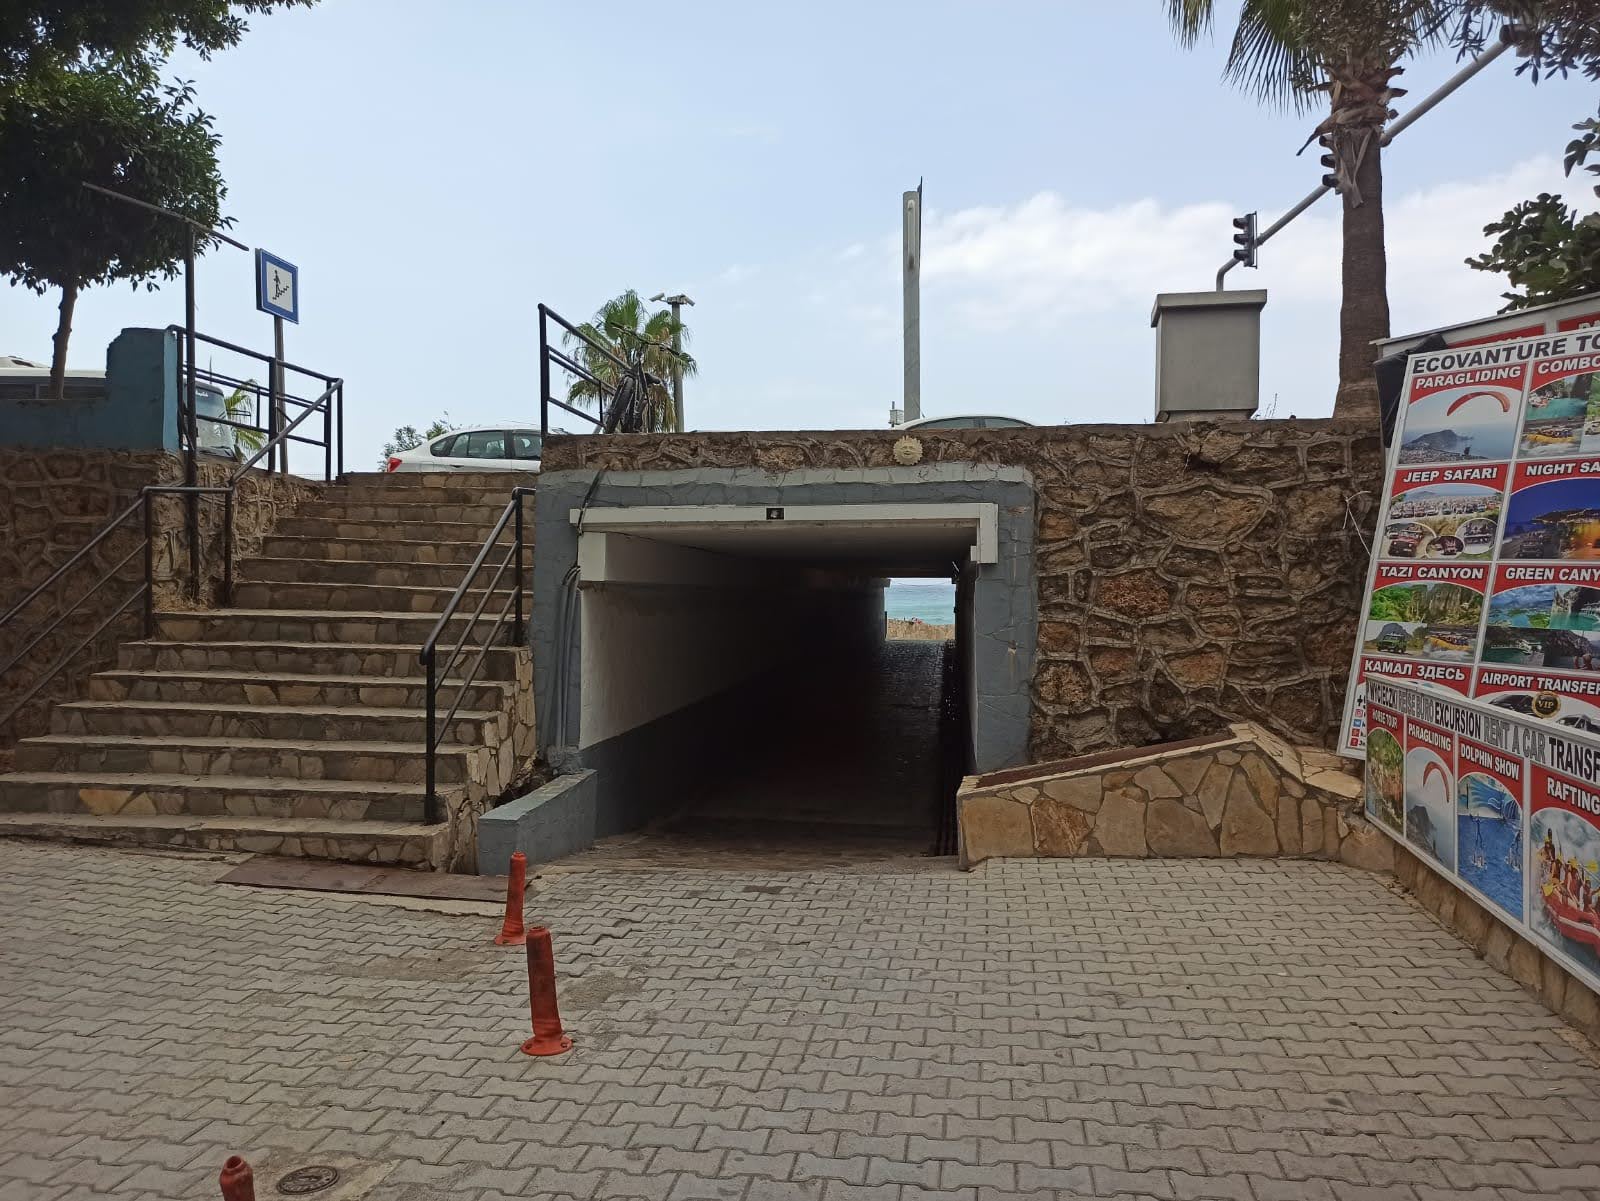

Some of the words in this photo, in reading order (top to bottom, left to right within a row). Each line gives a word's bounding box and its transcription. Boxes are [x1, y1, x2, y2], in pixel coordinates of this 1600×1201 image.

[1413, 338, 1567, 374] ECOVANTURE
[1416, 366, 1520, 389] PARAGLIDING
[1403, 471, 1439, 482] JEEP
[1443, 467, 1498, 480] SAFARI
[1526, 463, 1576, 476] NIGHT
[1580, 461, 1600, 473] SA
[1381, 566, 1413, 577] TAZI
[1417, 567, 1484, 579] CANYON
[1505, 567, 1555, 580] GREEN
[1559, 568, 1600, 581] CANY
[1364, 660, 1413, 676] КАМАЛ
[1417, 665, 1465, 681] ЗДЕСЬ
[1481, 672, 1534, 688] AIRPORT
[1538, 700, 1554, 709] VIP
[1408, 723, 1451, 751] PARAGLIDING
[1435, 701, 1481, 740] EXCURSION
[1484, 716, 1510, 750] RENT
[1512, 725, 1520, 755] A
[1522, 728, 1546, 764] CAR
[1460, 743, 1493, 769] DOLPHIN
[1494, 756, 1520, 780] SHOW
[1547, 777, 1600, 815] RAFTING
